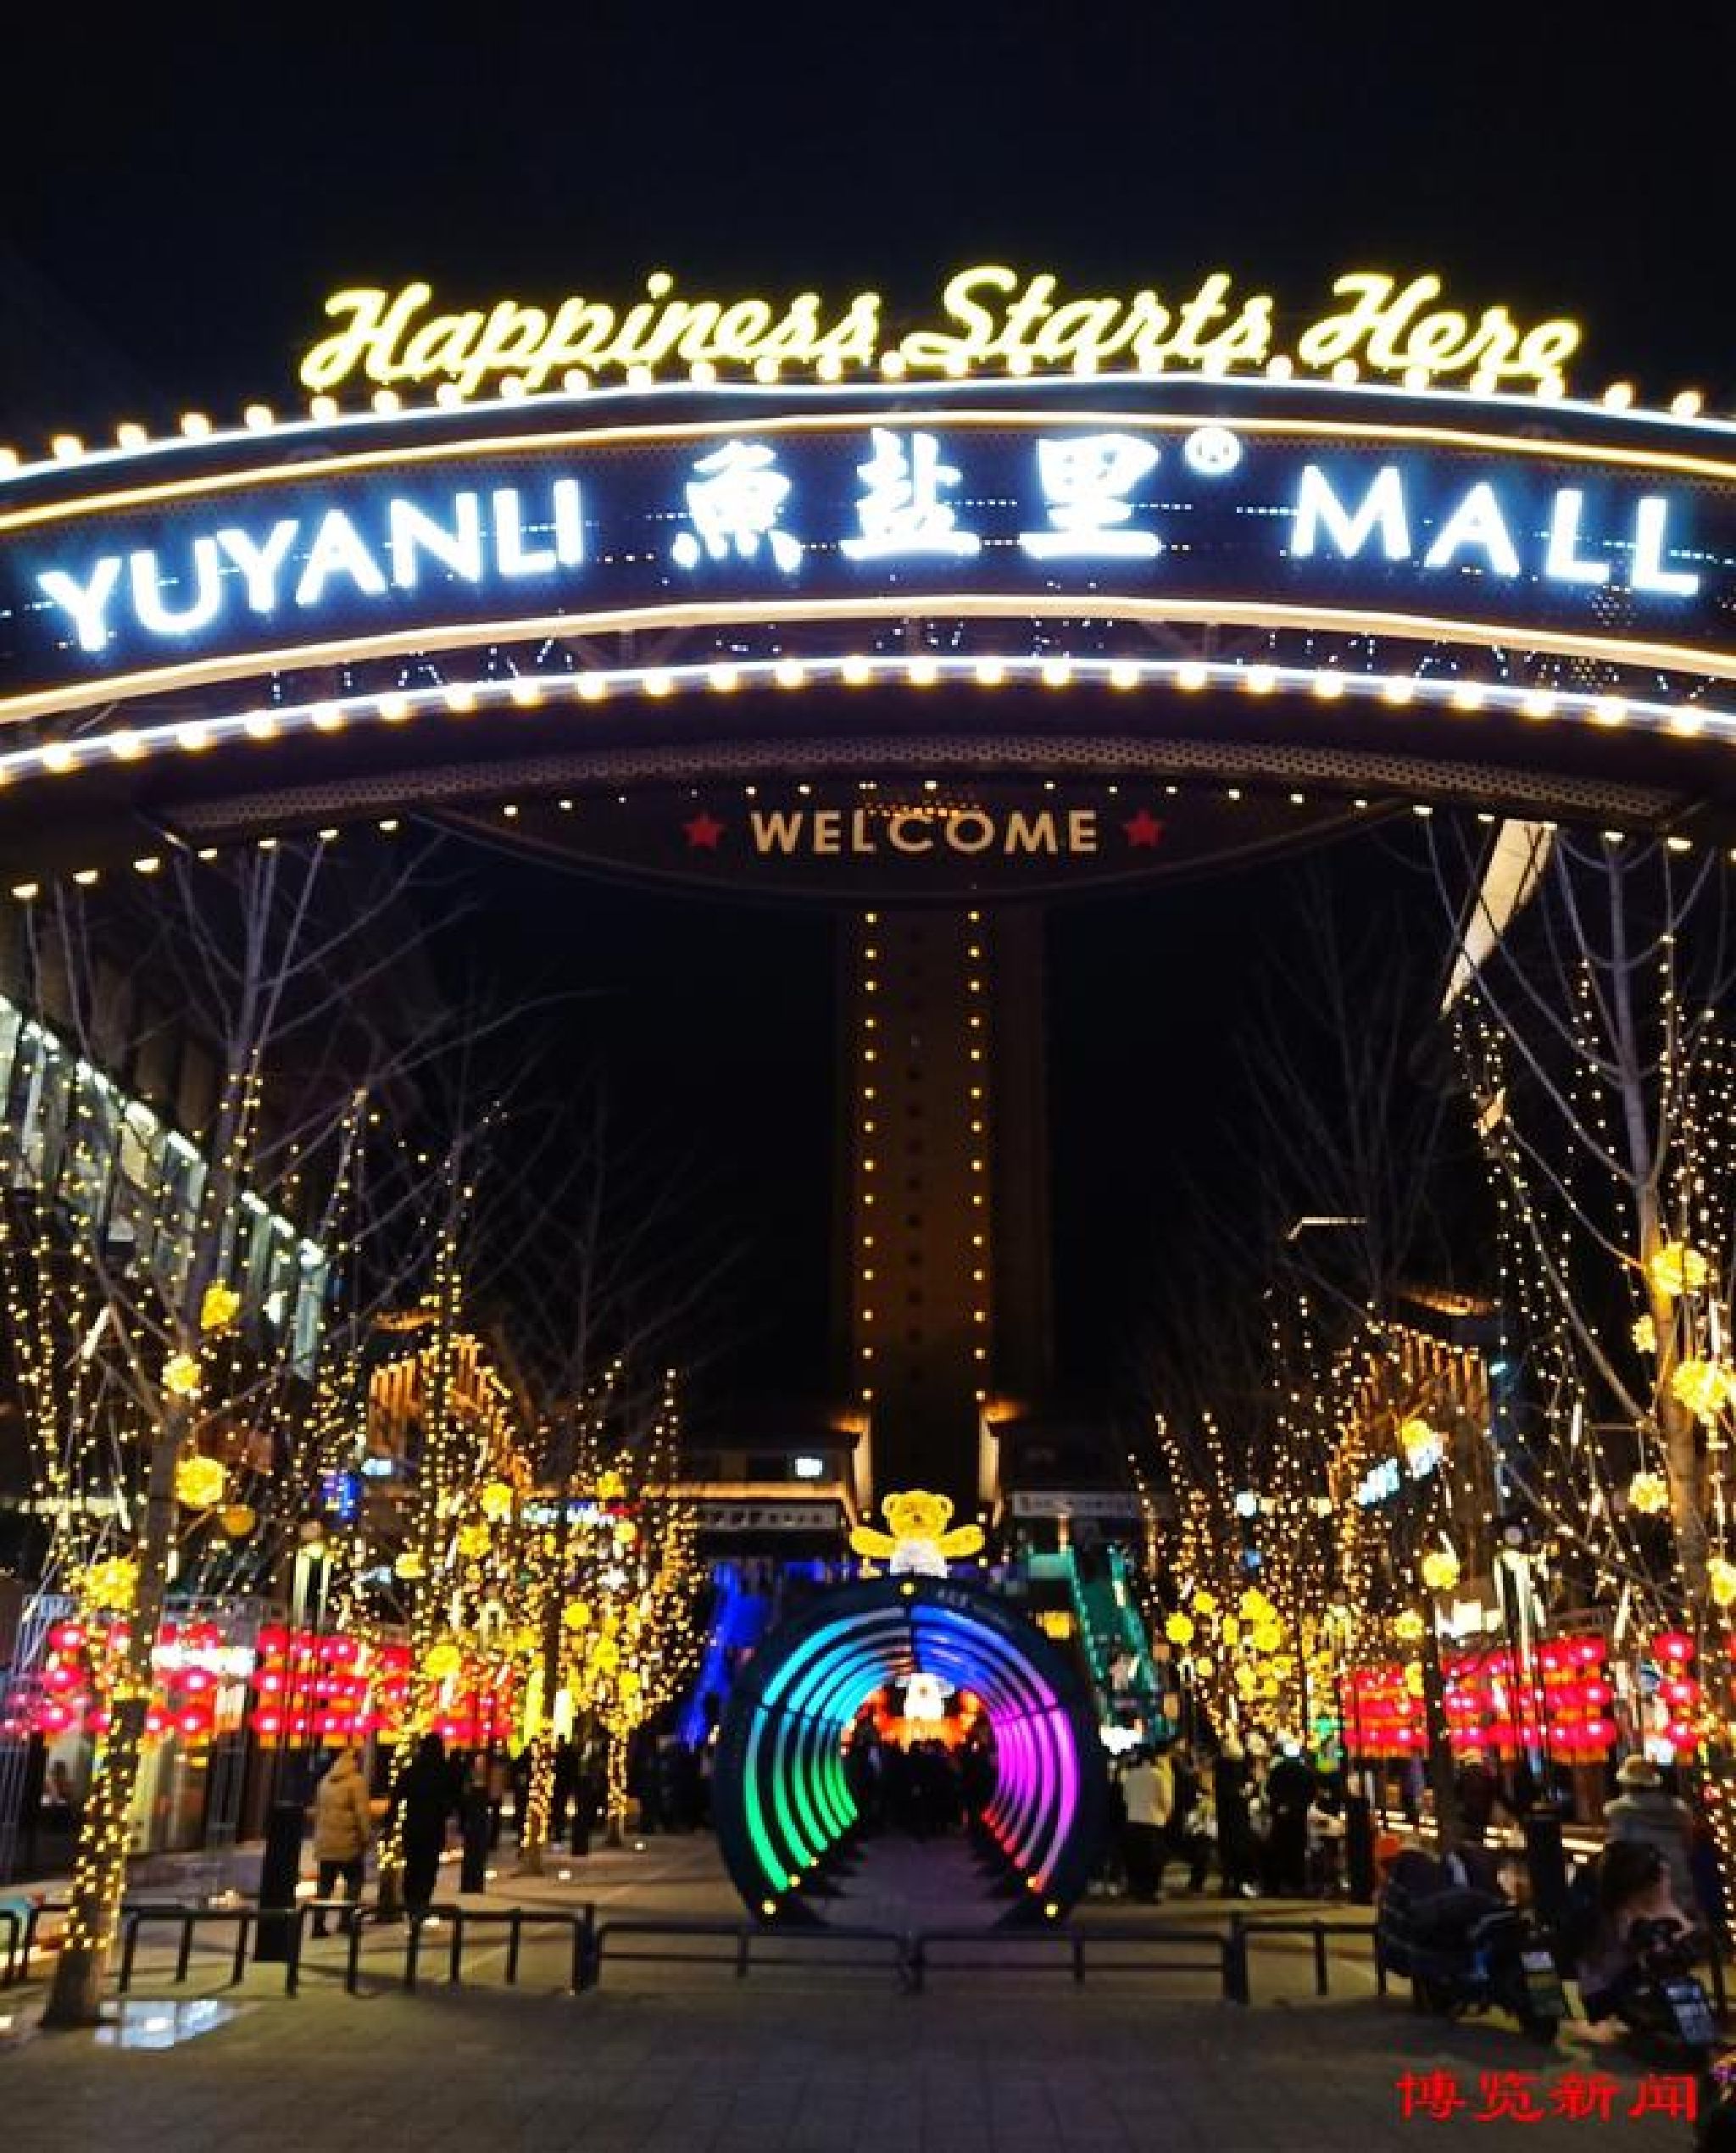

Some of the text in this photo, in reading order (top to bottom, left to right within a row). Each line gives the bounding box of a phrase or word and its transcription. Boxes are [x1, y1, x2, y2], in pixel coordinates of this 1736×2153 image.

[300, 264, 1583, 395] Happiness Starts Here
[37, 478, 585, 654] YUYANLI
[1289, 464, 1701, 596] MALL
[750, 809, 1099, 854] WELCOME
